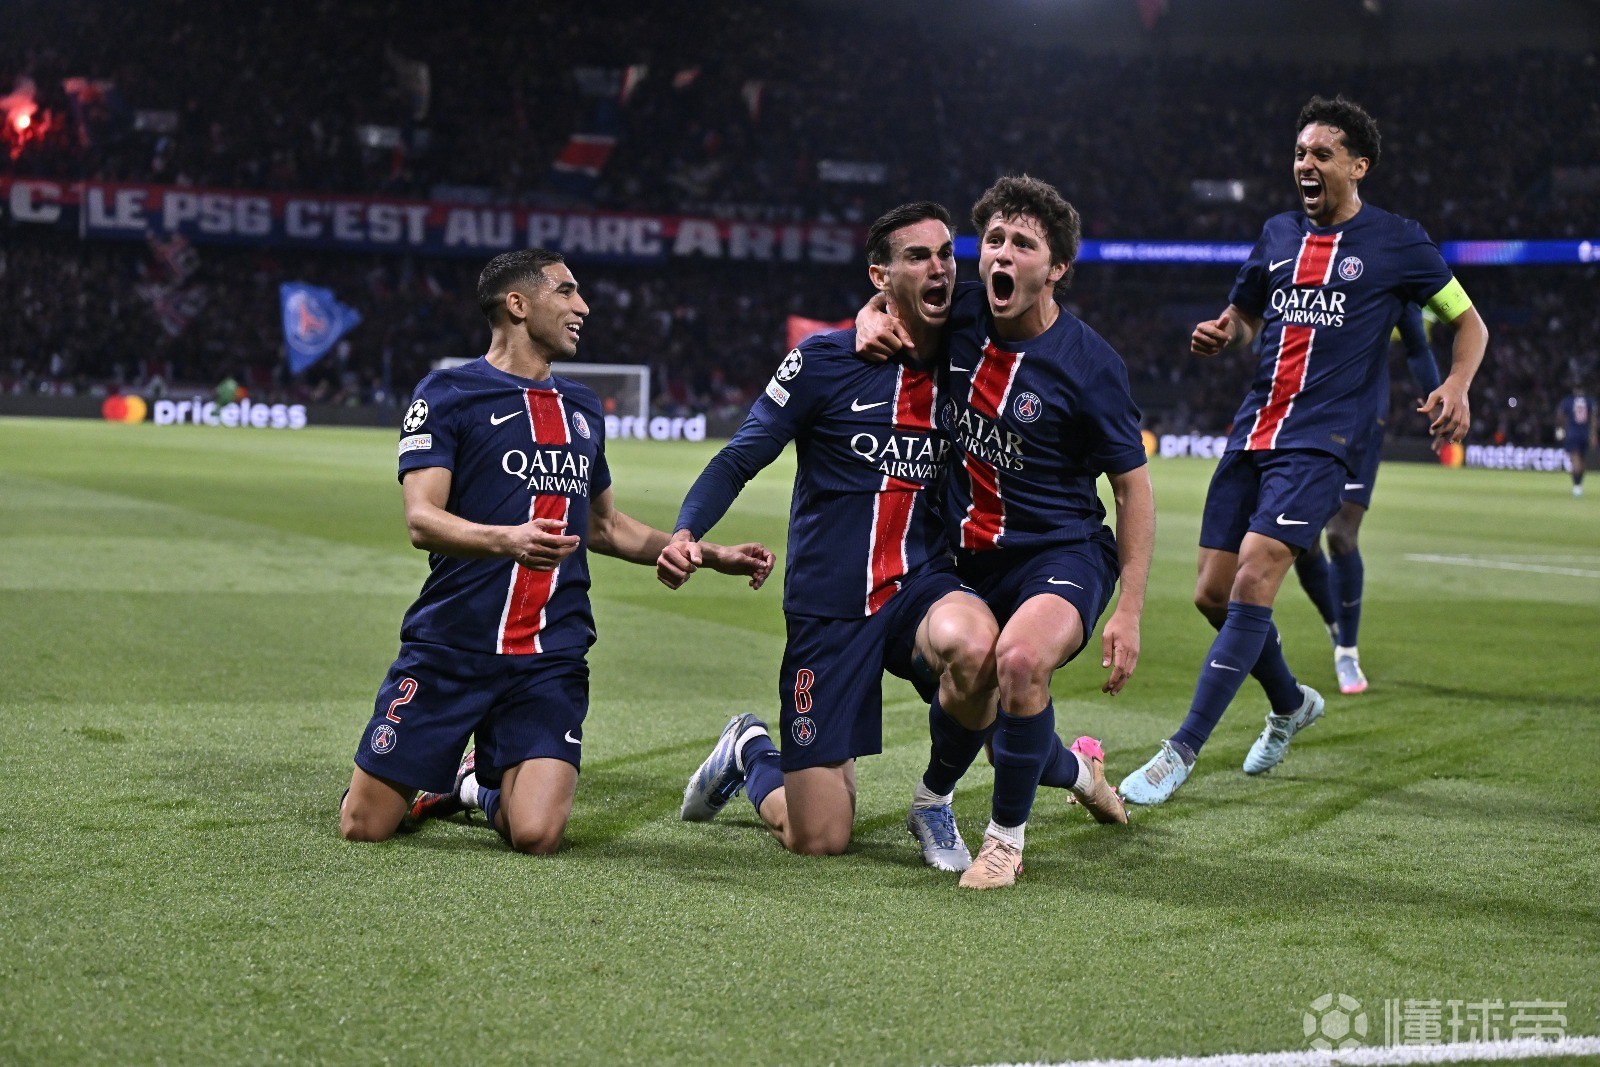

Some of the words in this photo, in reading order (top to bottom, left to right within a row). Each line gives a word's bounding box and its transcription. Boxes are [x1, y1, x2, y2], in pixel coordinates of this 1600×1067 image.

[88, 187, 149, 229] LE
[162, 190, 273, 235] PSG
[285, 199, 430, 244] C'EST
[443, 207, 514, 249] AU
[527, 212, 662, 257] PARC
[673, 219, 855, 263] ARIS
[1271, 288, 1346, 313] QATAR
[1281, 310, 1344, 327] AIRWAYS
[153, 396, 307, 429] priceless
[604, 413, 706, 442] ercard
[850, 433, 950, 463] QATAR
[1159, 430, 1228, 460] price
[502, 449, 589, 481] QATAR
[878, 460, 944, 479] AIRWAY
[526, 475, 588, 498] AIRWAYS
[386, 678, 418, 723] 2
[795, 668, 815, 714] 8
